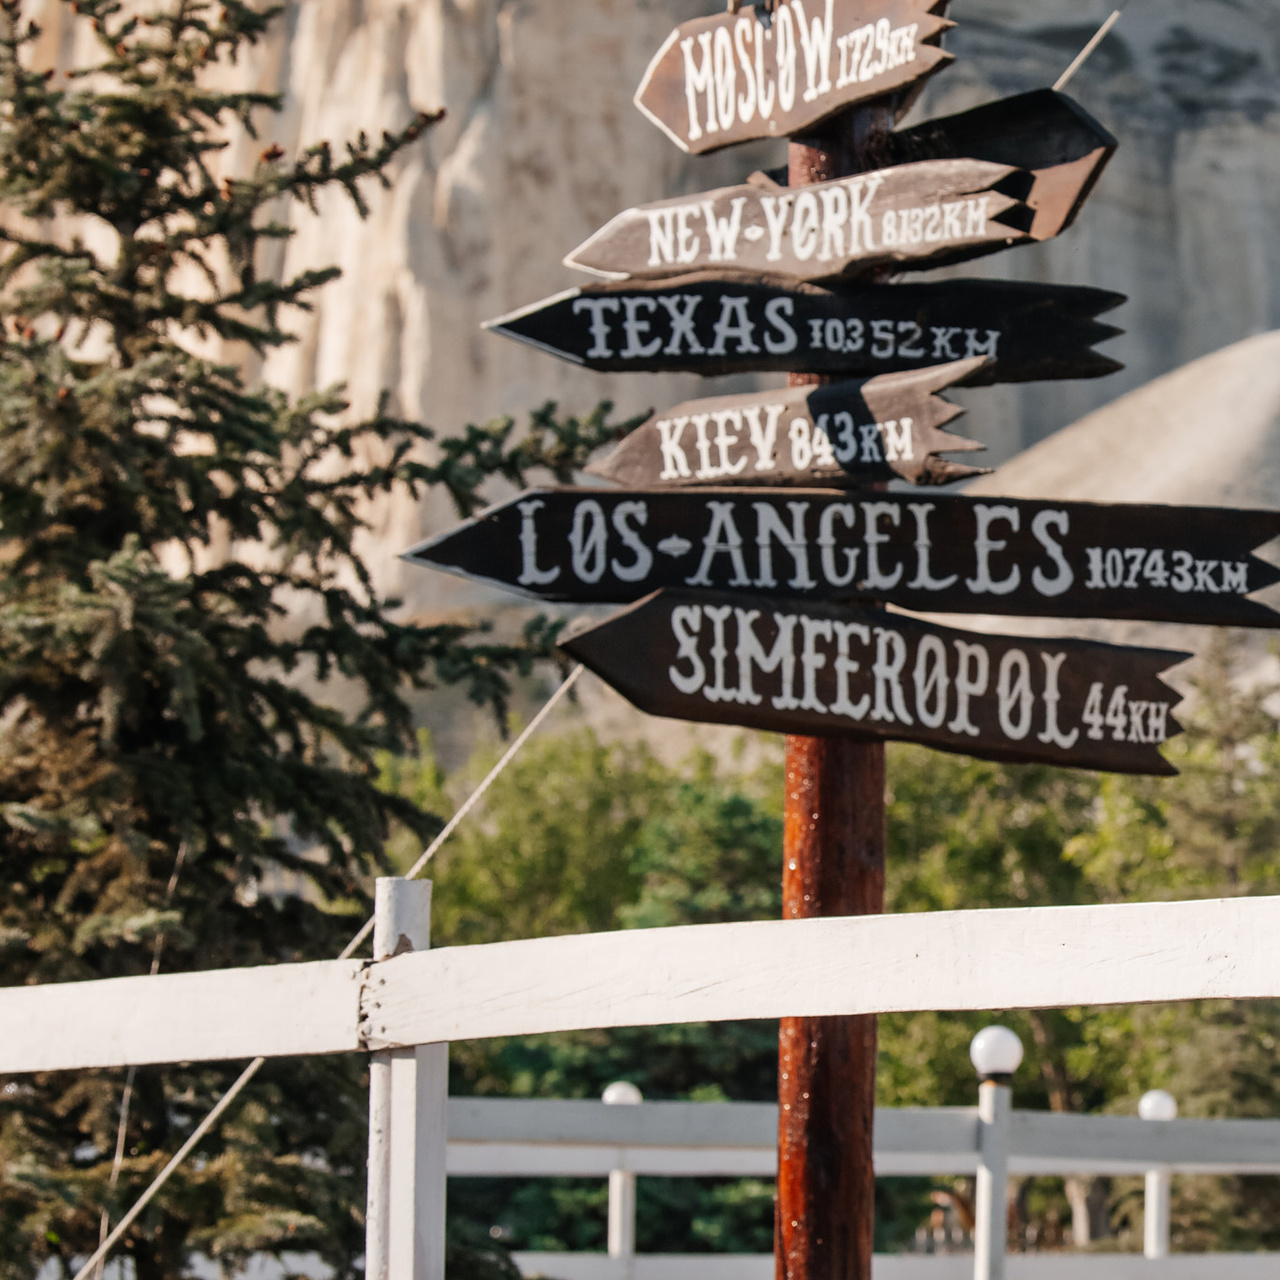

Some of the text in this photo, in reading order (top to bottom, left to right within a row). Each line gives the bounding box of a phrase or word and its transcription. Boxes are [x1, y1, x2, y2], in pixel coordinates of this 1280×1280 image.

[572, 294, 798, 359] TEXAS
[656, 404, 785, 481] KIEV
[669, 604, 1079, 750] SIMFEROPOL
